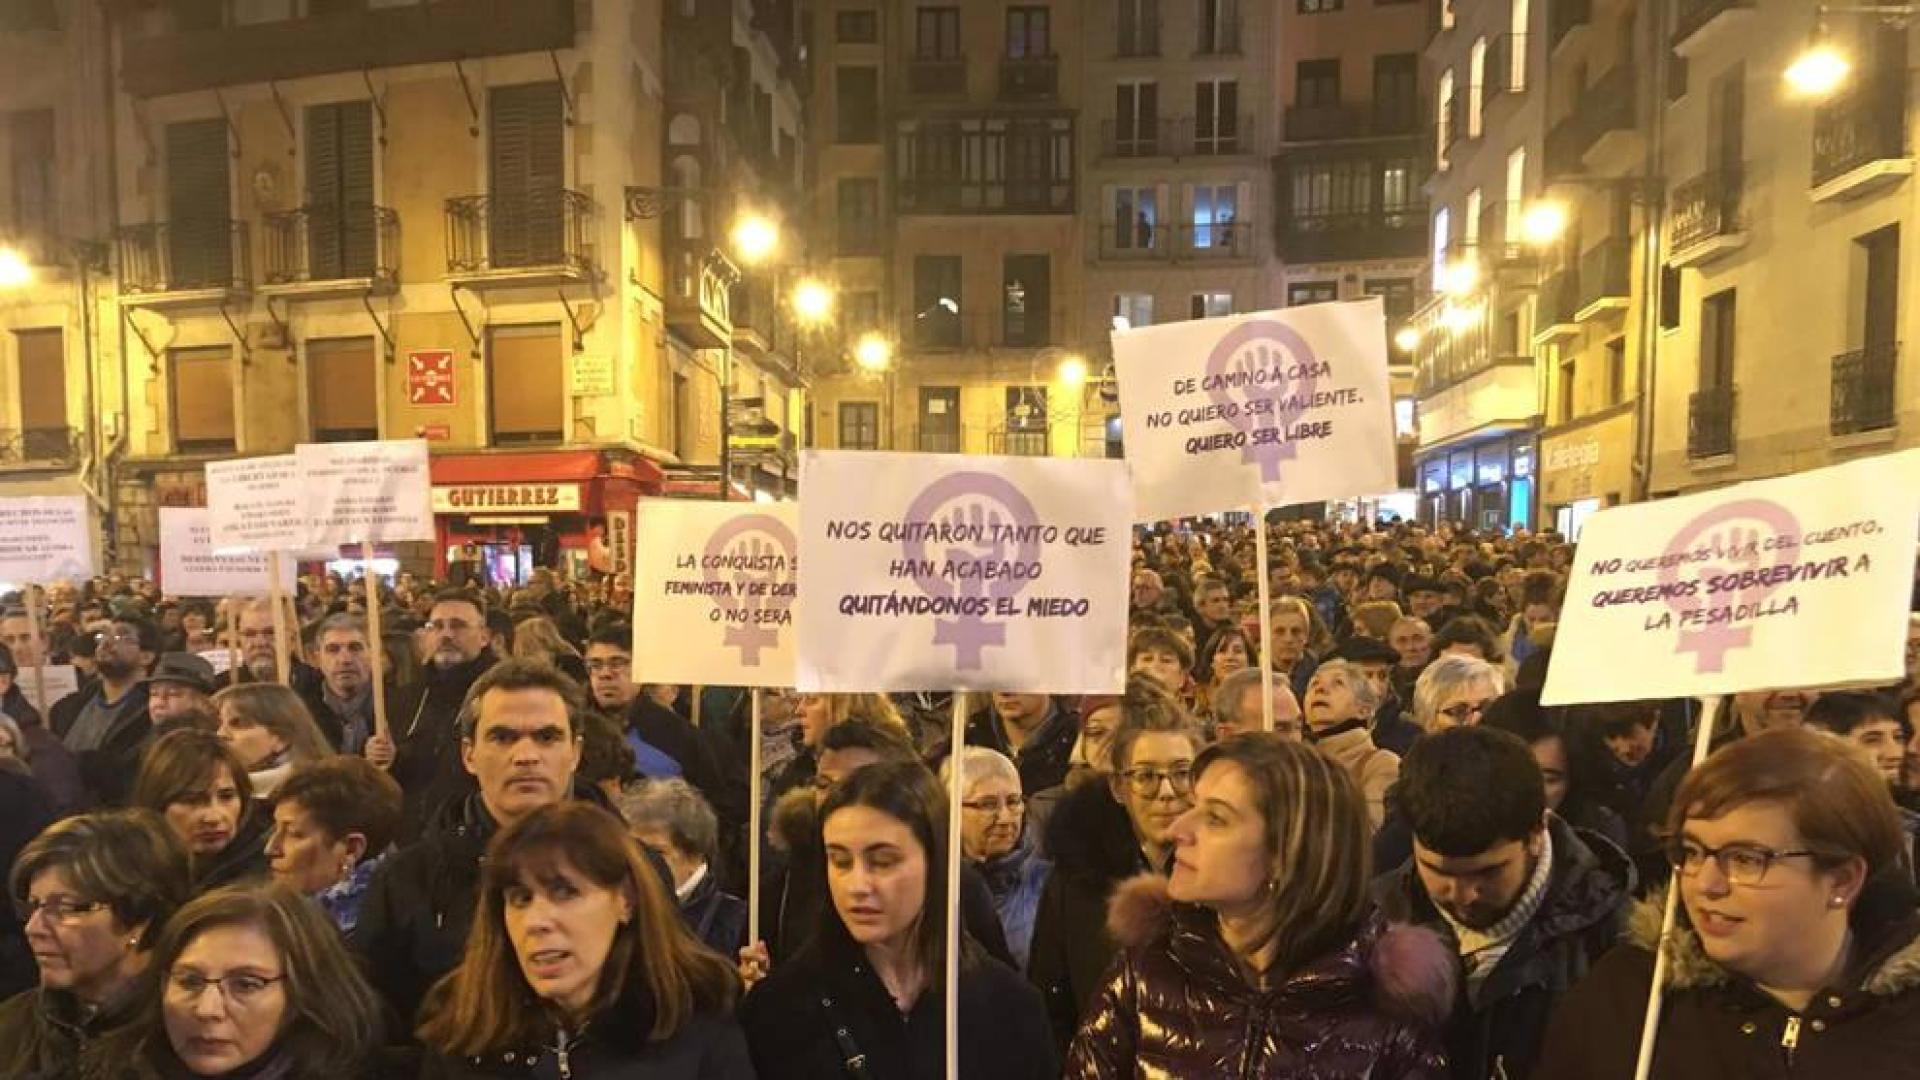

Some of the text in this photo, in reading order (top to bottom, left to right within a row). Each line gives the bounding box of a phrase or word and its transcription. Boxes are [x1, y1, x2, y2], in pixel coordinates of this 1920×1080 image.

[1174, 360, 1331, 395] DE CAMINO A CASA
[1146, 387, 1364, 429] NO QUIERO SER VALIENTE.
[1185, 420, 1333, 454] QUIERO SER LIBRE
[449, 487, 559, 507] GUTIERREZ
[826, 520, 1106, 545] NOS QUITARON TANTO QUE
[677, 554, 695, 569] LA
[702, 556, 785, 571] CONQUISTA
[1591, 558, 1622, 575] NO
[1625, 548, 1709, 572] QUEREMOS
[1713, 541, 1760, 562] VIVIR
[1763, 533, 1798, 552] DEL
[890, 559, 1042, 580] HAN ACABADO
[1592, 552, 1870, 608] QUEREMOS SOBREVIVIR A
[665, 580, 732, 596] FEMINISTA
[736, 582, 745, 595] Y
[748, 583, 767, 596] DE
[709, 608, 721, 622] O
[725, 608, 749, 622] NO
[839, 590, 1089, 617] QUITÁNDONOS EL MIEDO
[1644, 595, 1799, 631] LA PESADILLA
